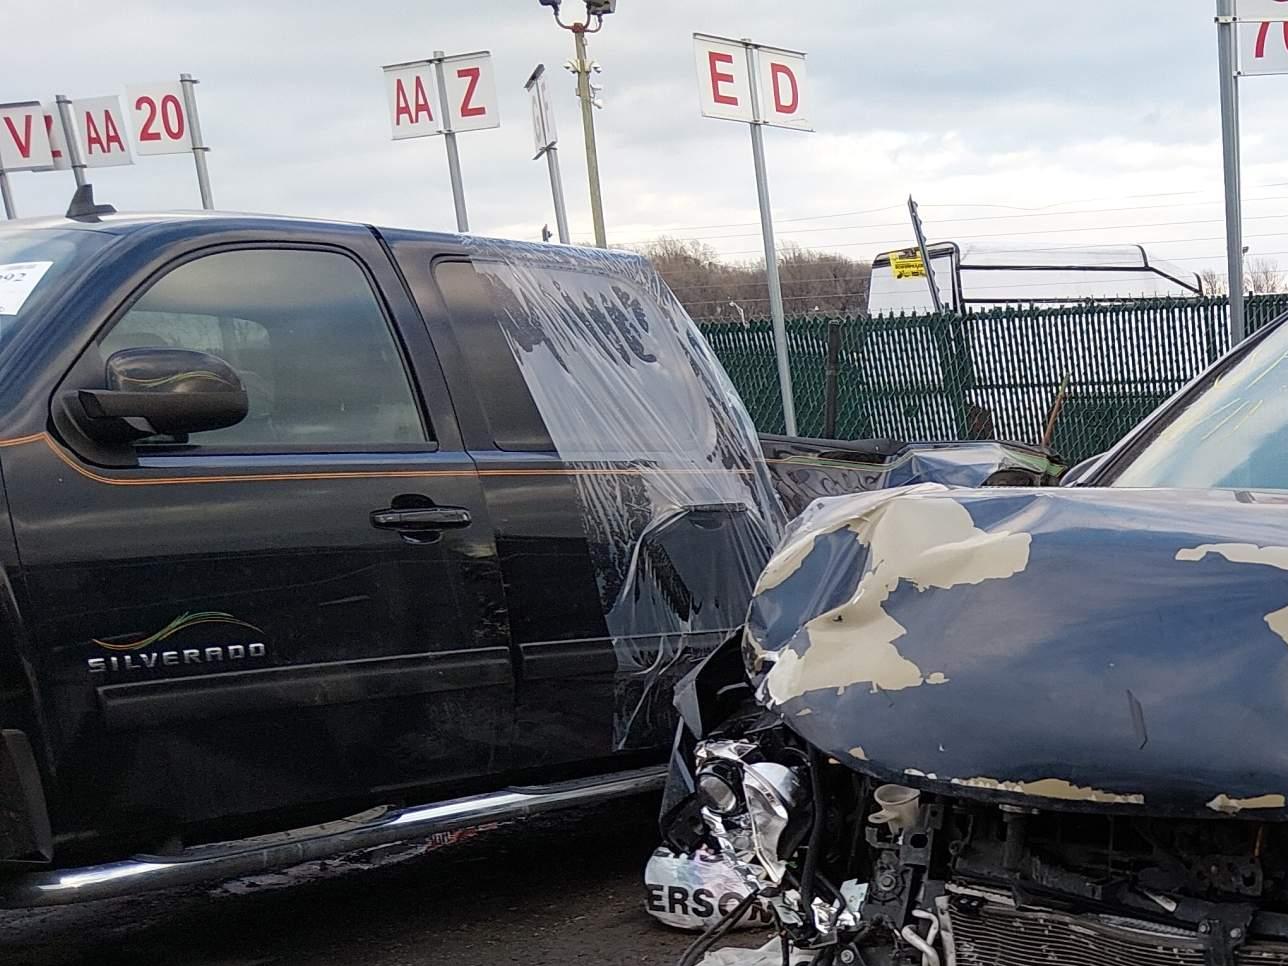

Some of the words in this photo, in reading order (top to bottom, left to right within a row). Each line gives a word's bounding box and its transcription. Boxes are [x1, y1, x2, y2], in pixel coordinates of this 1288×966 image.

[395, 75, 434, 126] AA
[456, 67, 487, 118] Z
[708, 51, 739, 106] E
[770, 62, 799, 114] D
[3, 114, 33, 159] V
[85, 109, 126, 155] AA
[135, 94, 185, 142] 20
[87, 642, 267, 673] SILVERADO
